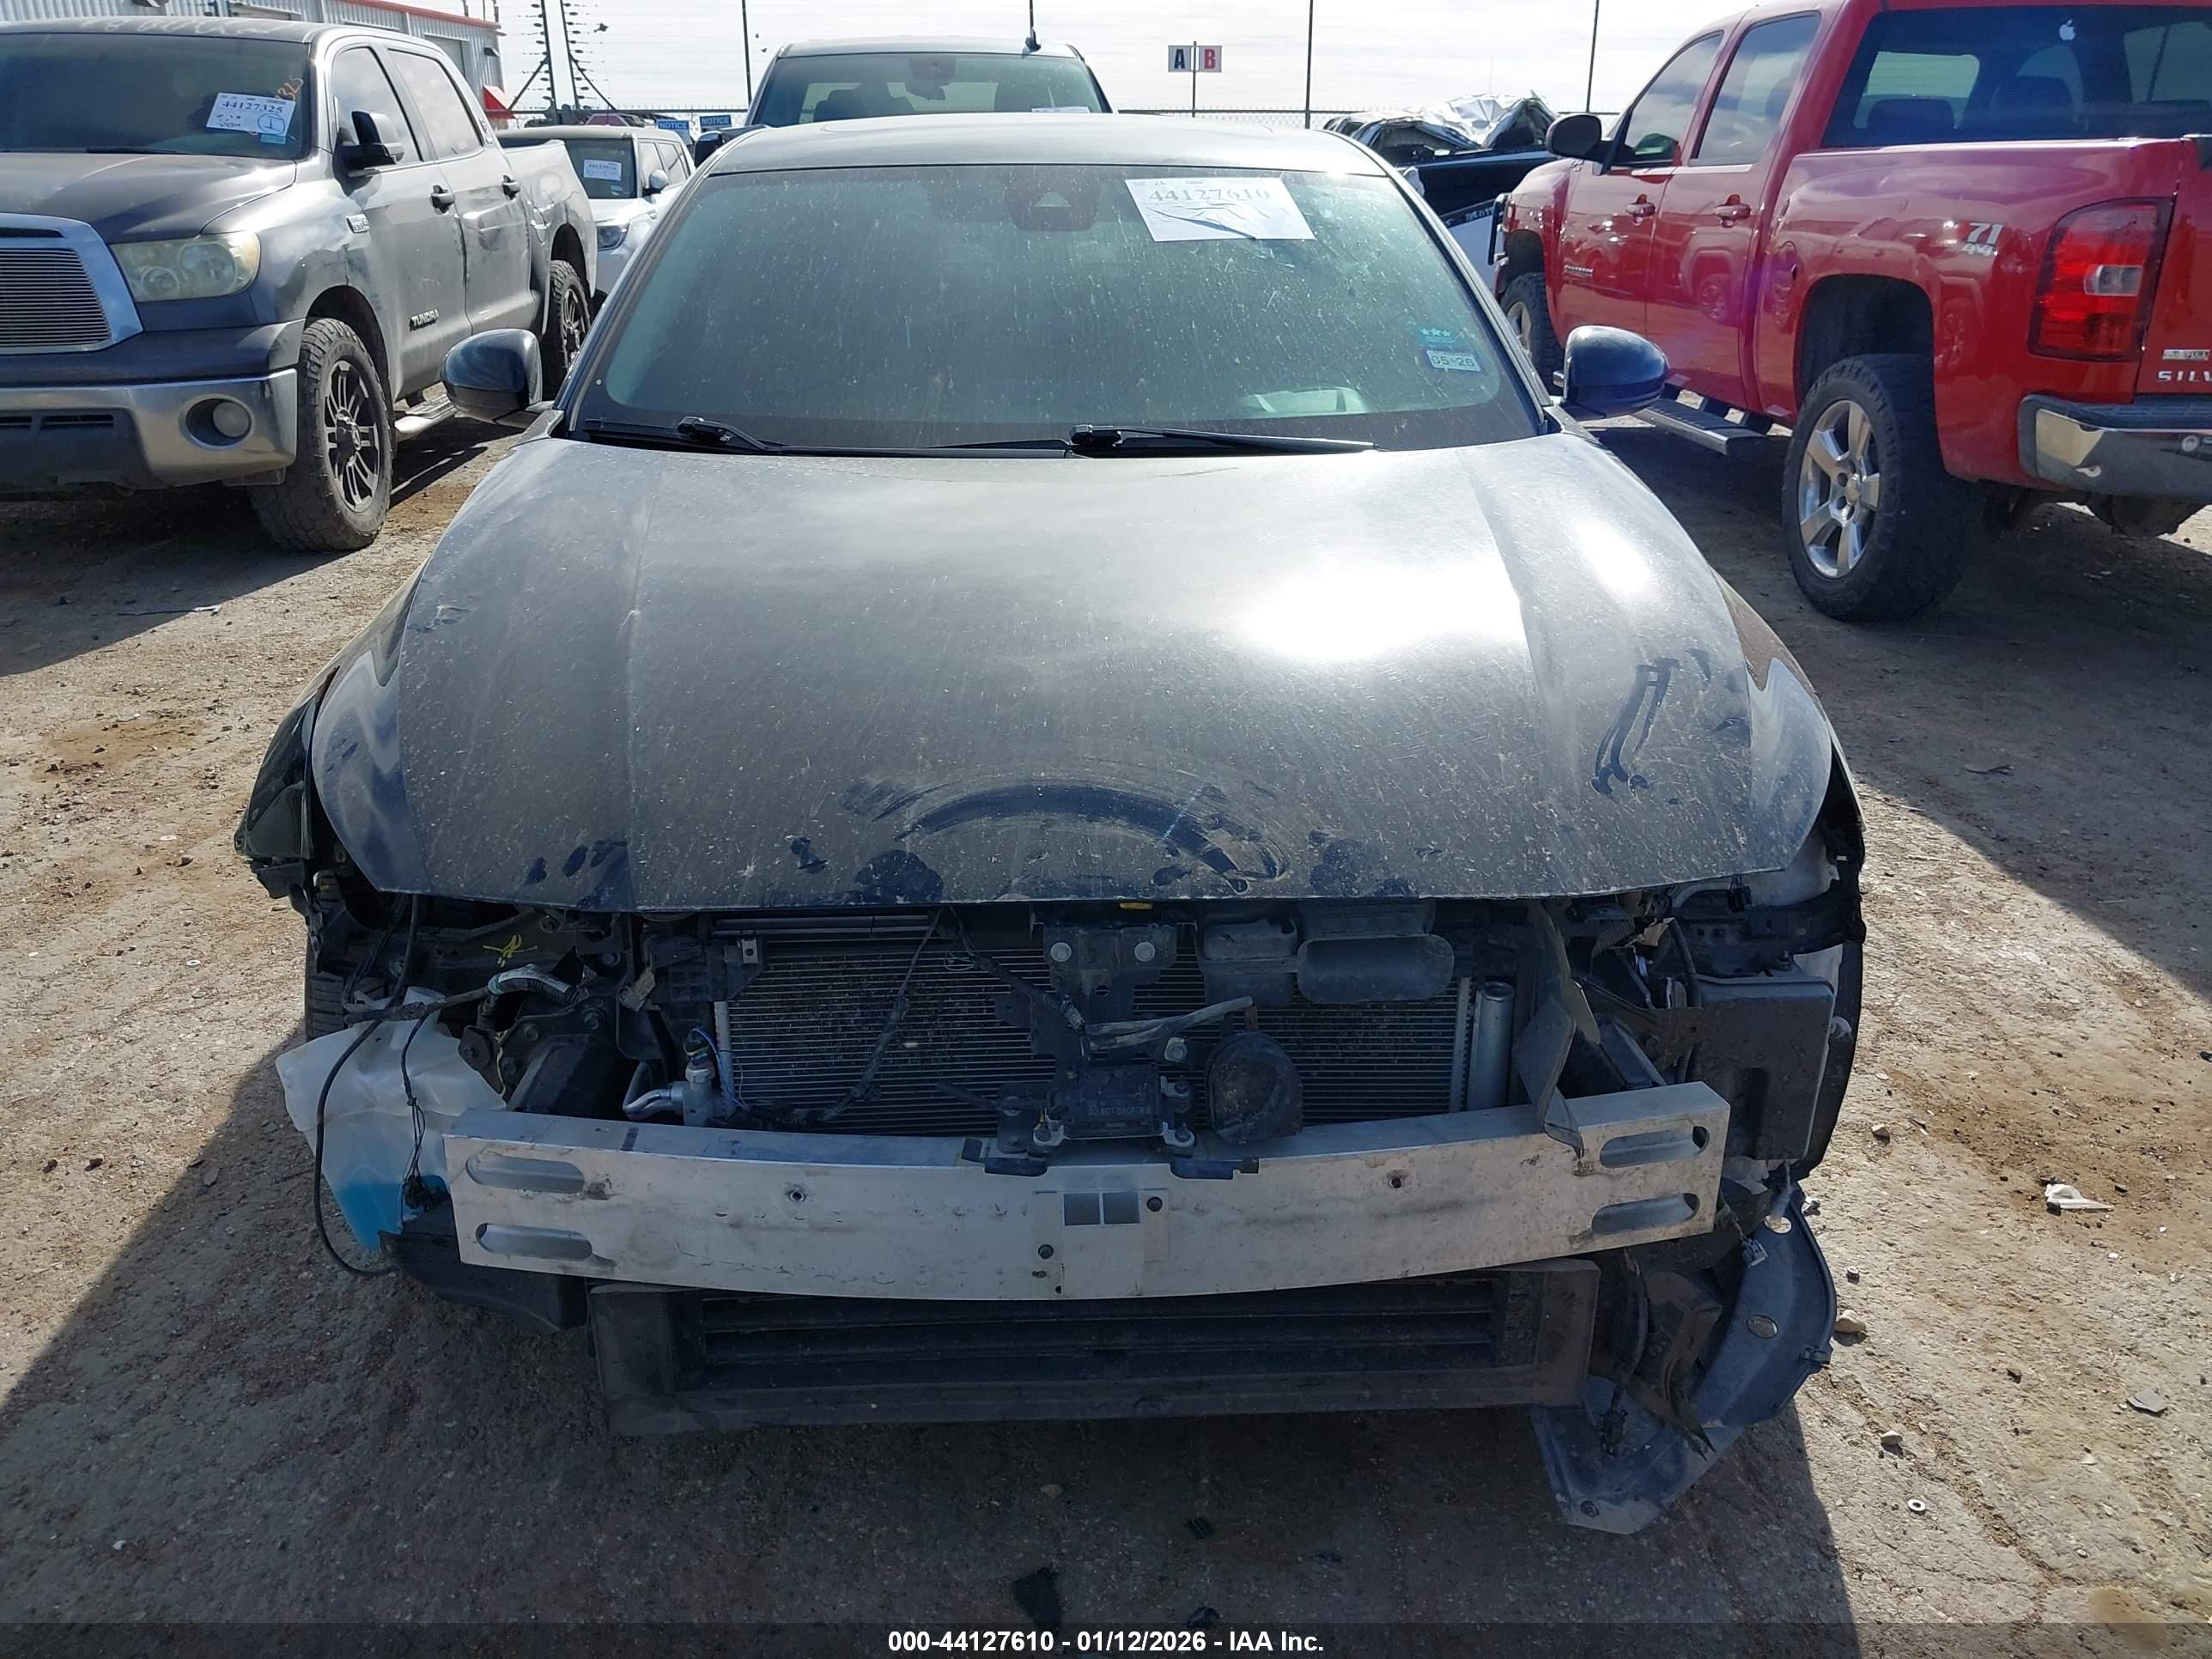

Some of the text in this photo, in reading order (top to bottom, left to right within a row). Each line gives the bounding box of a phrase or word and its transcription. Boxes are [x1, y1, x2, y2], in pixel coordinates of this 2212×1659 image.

[1174, 48, 1186, 70] A
[1204, 48, 1216, 70] B
[222, 100, 284, 113] 44127325
[701, 116, 730, 125] NOTICE
[1148, 188, 1270, 202] 44127610
[410, 308, 439, 326] TUNDRA
